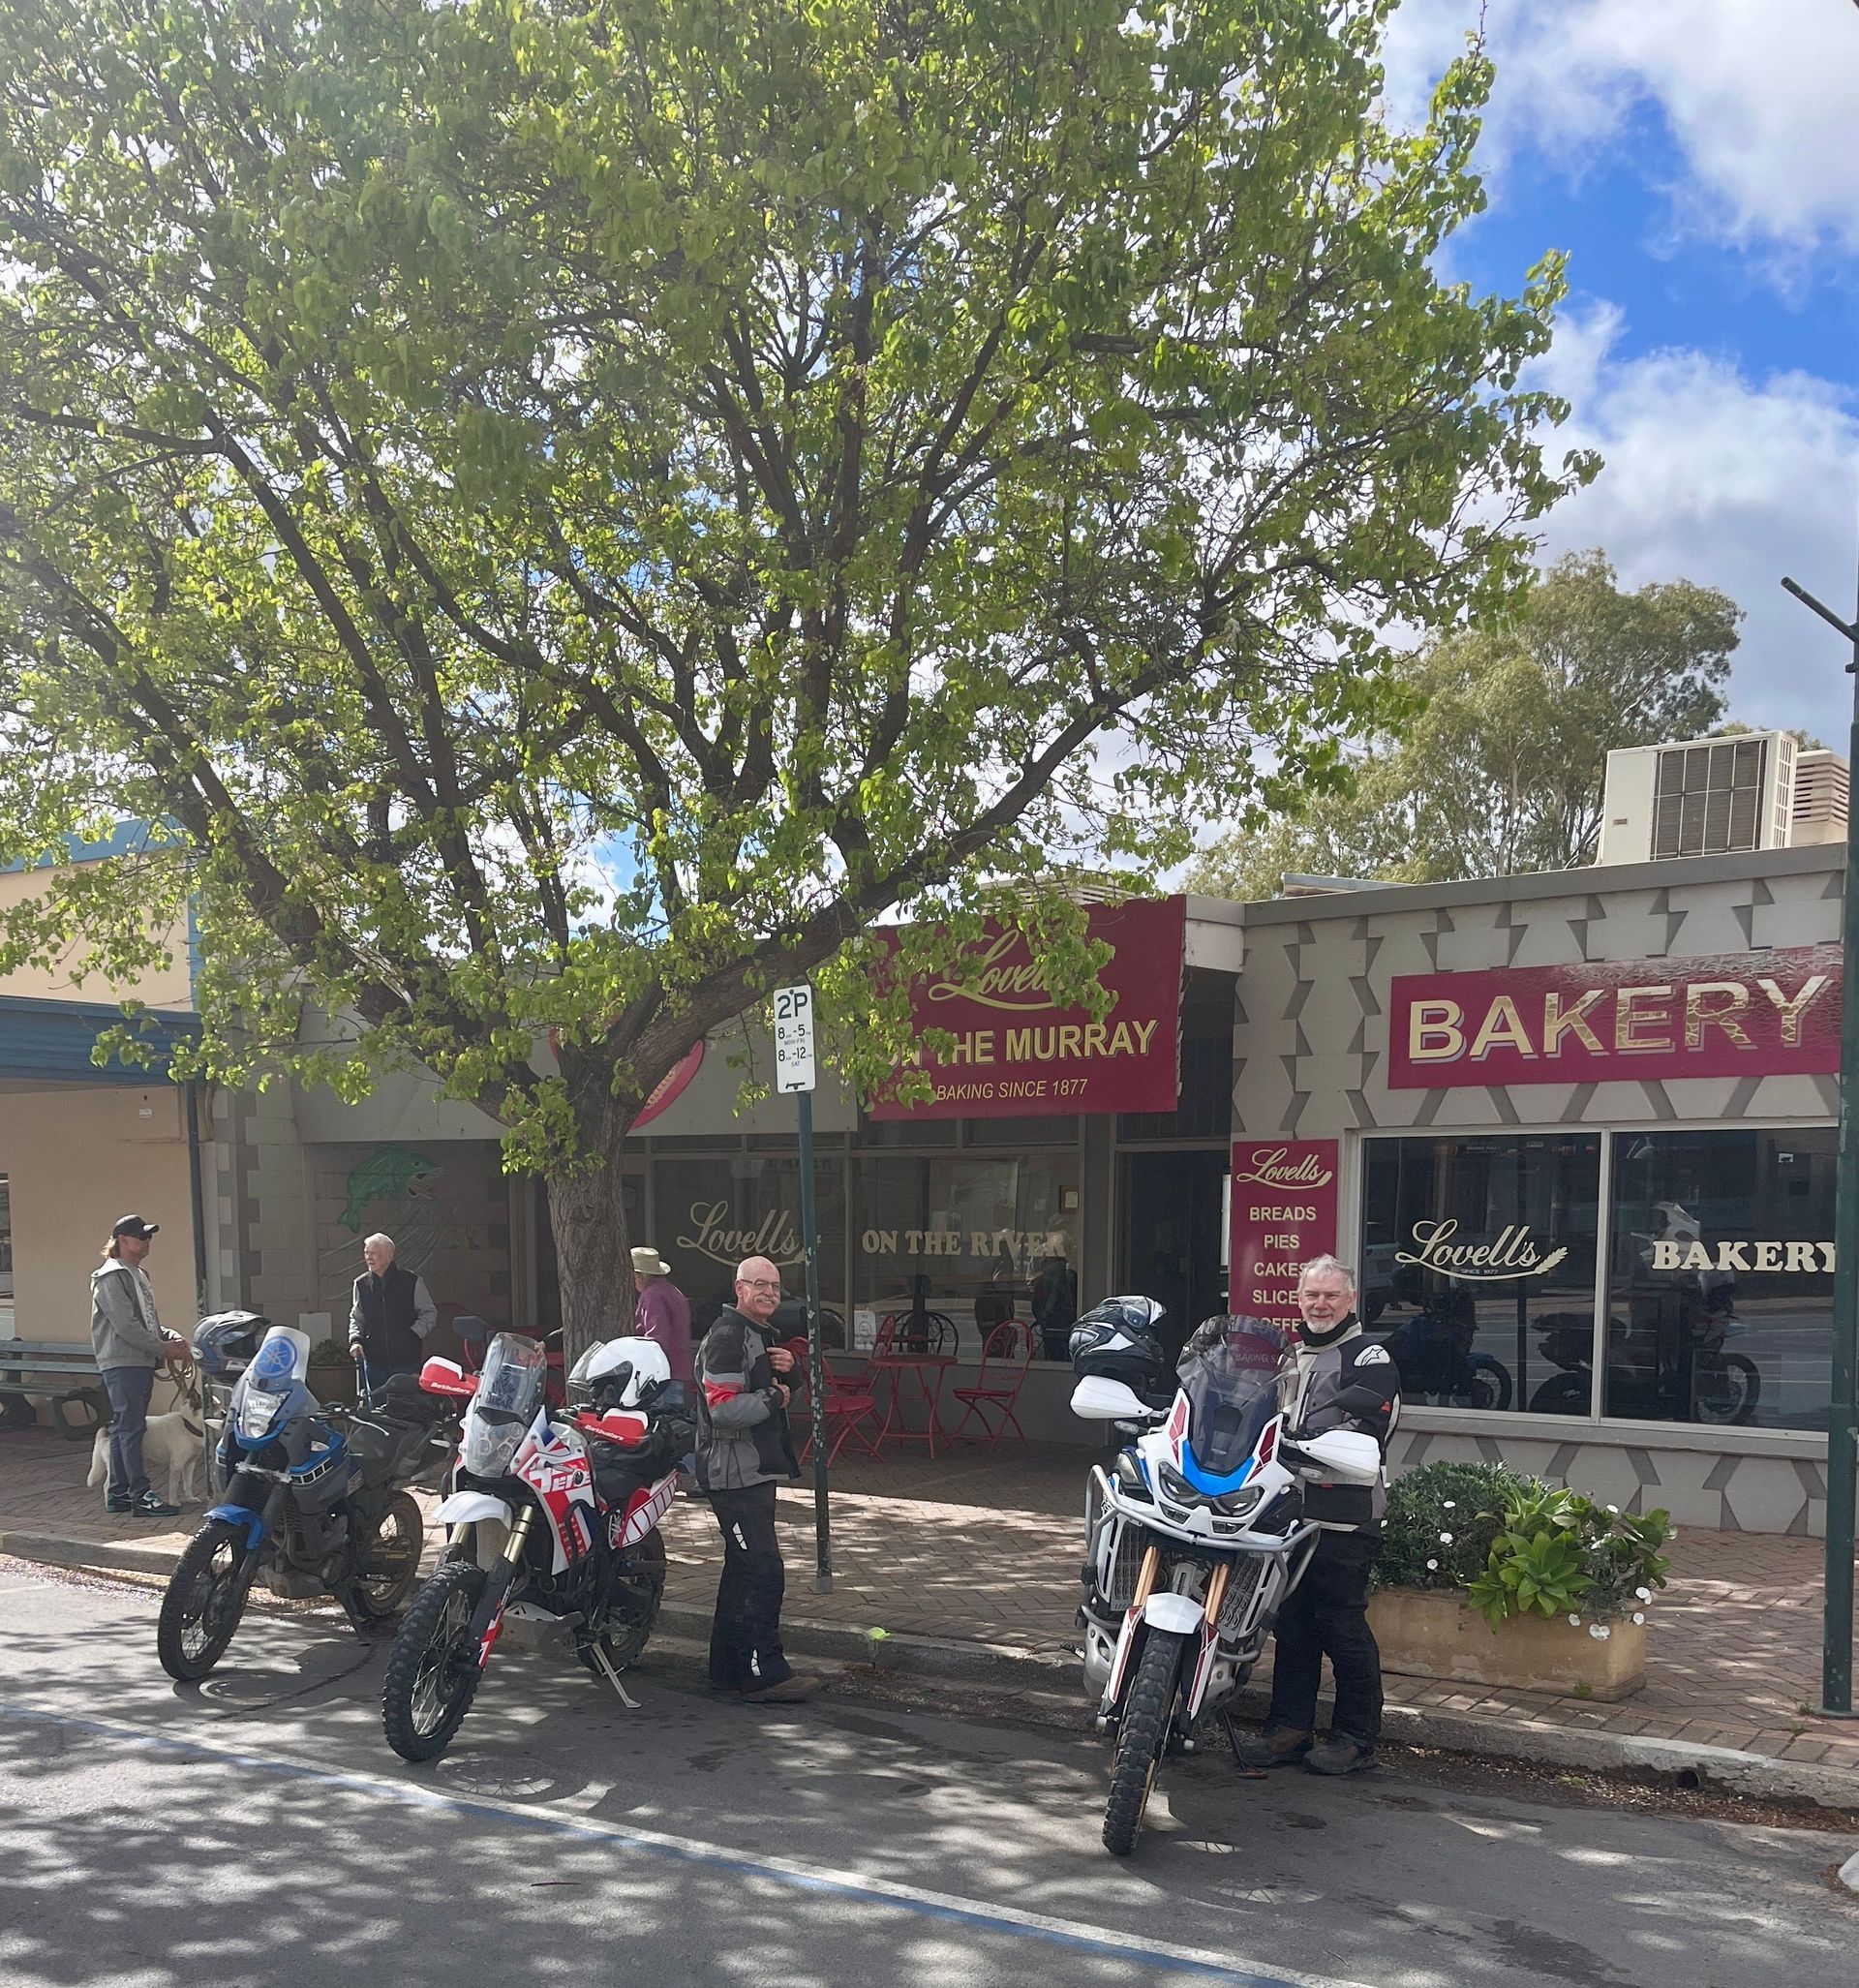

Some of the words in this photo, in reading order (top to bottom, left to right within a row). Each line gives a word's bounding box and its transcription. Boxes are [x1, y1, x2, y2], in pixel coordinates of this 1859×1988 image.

[777, 992, 808, 1020] 2P
[1409, 975, 1835, 1064] BAKERY
[1005, 1019, 1160, 1062] MURRAY
[936, 1082, 993, 1101] BAKING
[998, 1080, 1047, 1098] SINCE
[1051, 1078, 1088, 1096] 1877
[1236, 1147, 1332, 1190] Lovells
[1249, 1206, 1317, 1221] BREADS
[676, 1200, 811, 1268] Lovells
[862, 1229, 899, 1255] ON
[904, 1230, 961, 1256] THE
[970, 1231, 1067, 1258] RIVER
[1264, 1234, 1300, 1249] PIES
[1652, 1240, 1836, 1273] BAKERY
[1252, 1289, 1299, 1305] SLICE
